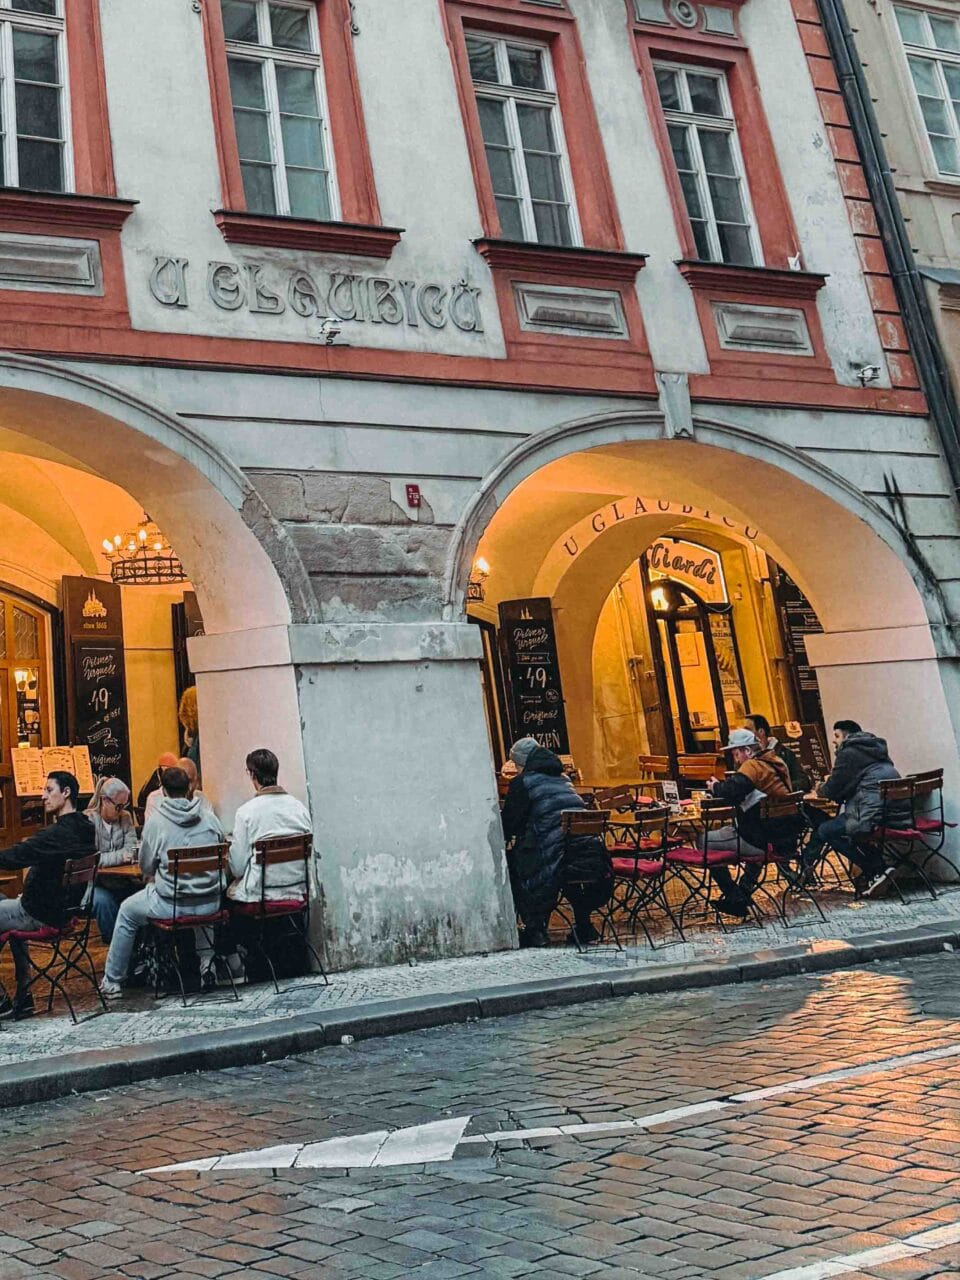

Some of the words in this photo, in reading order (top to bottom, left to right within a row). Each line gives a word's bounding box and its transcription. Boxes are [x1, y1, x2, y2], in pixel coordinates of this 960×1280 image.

[149, 256, 189, 309] U
[563, 535, 579, 557] U
[526, 667, 547, 688] 49
[91, 687, 108, 711] 49
